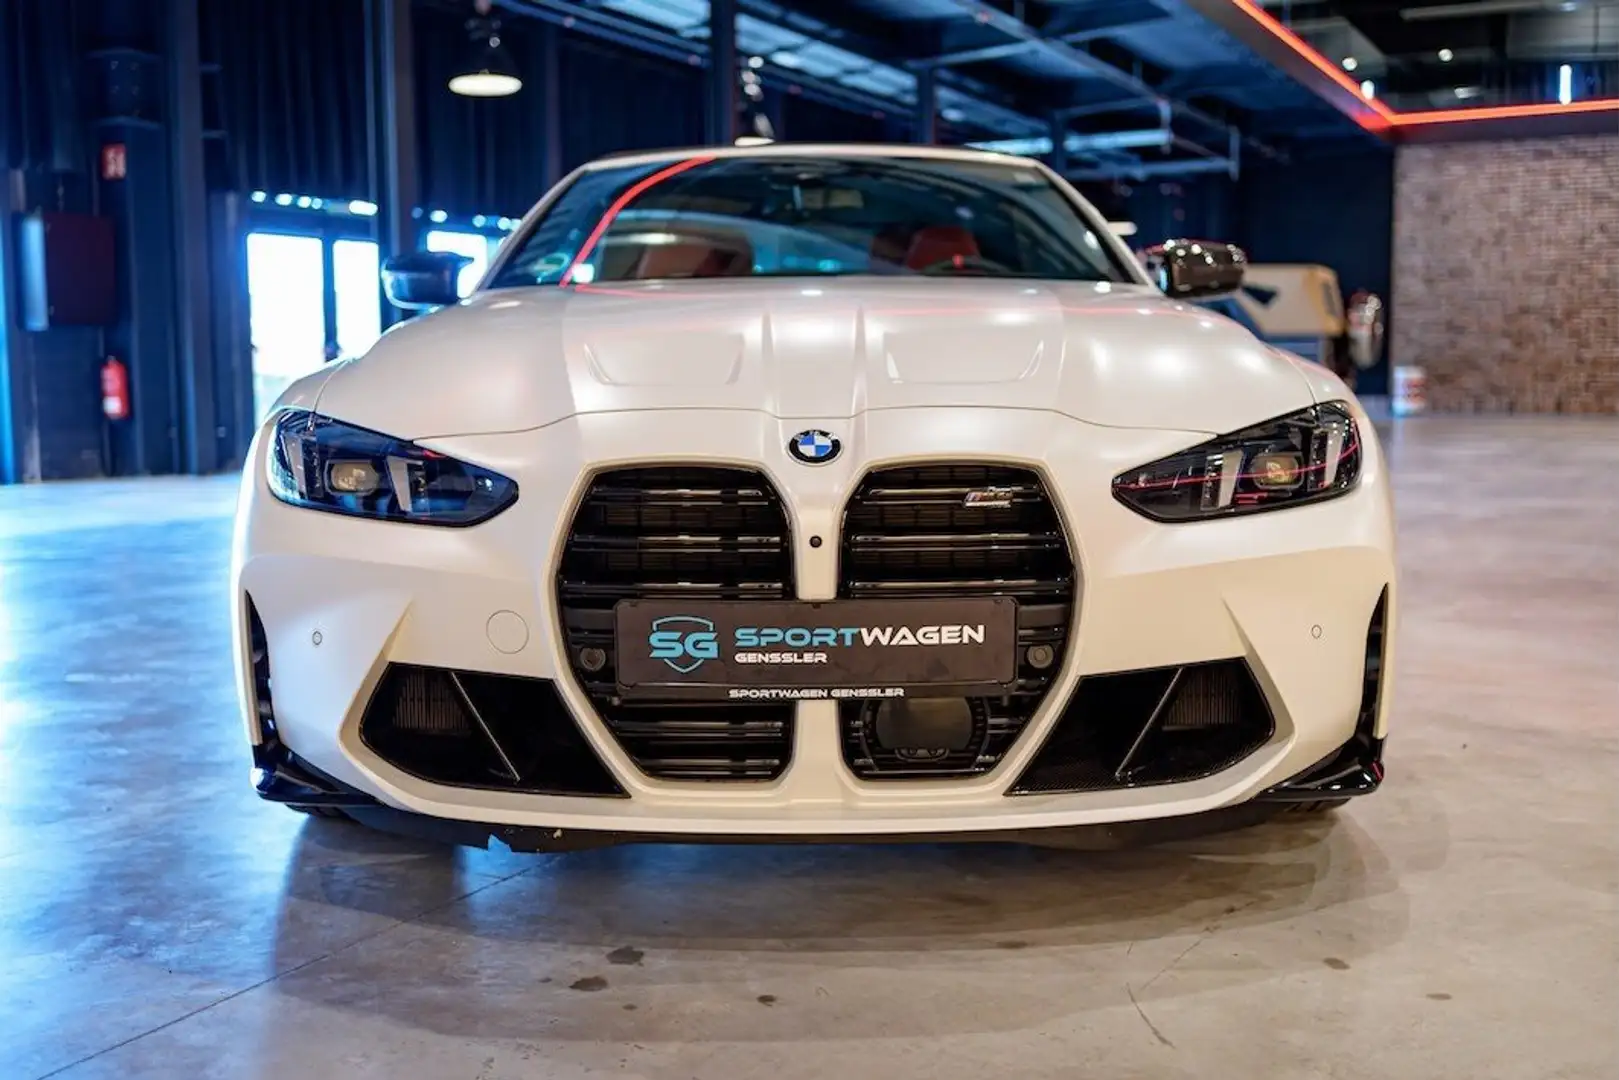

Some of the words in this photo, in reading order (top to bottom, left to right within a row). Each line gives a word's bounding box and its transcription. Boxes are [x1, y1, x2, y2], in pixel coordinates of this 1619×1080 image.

[734, 624, 986, 647] SPORTWAGEN
[649, 631, 719, 659] SG
[734, 652, 828, 664] GENSSLER
[728, 688, 829, 699] SPORTWAGEN
[830, 687, 905, 698] GENSSLER
